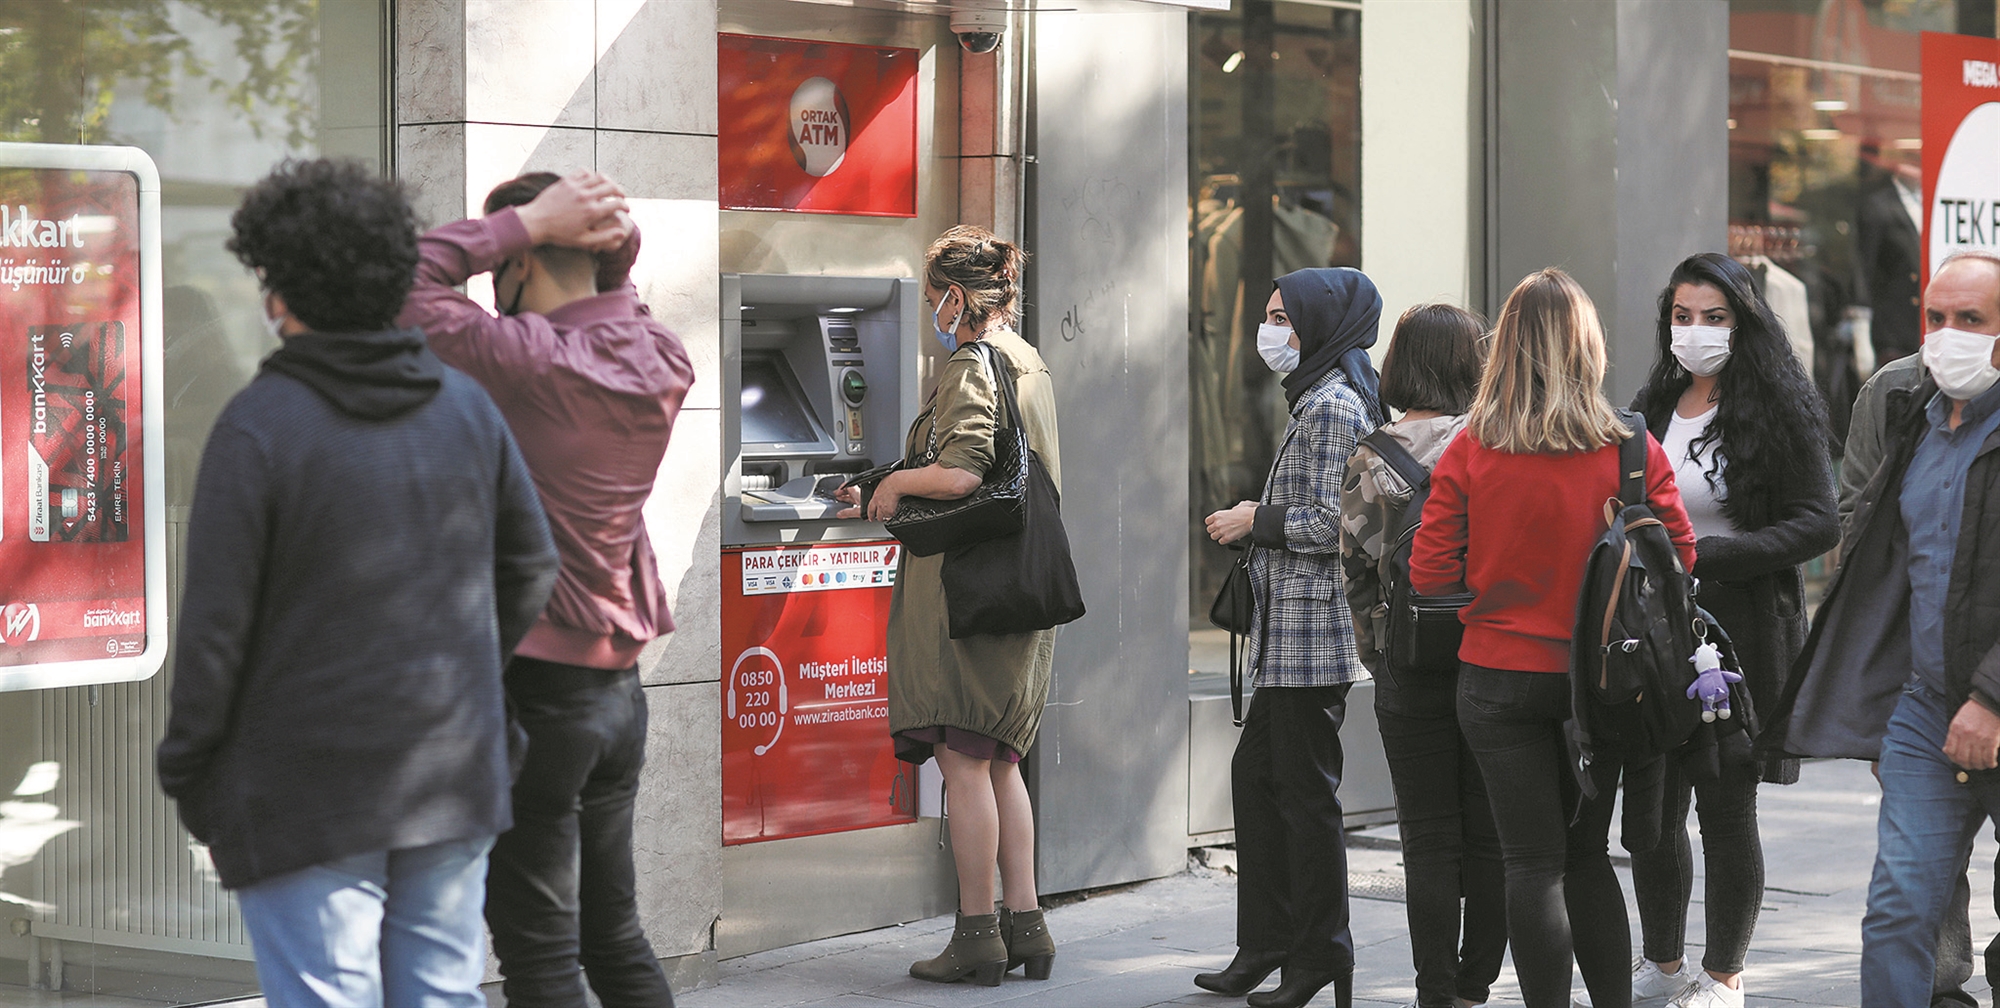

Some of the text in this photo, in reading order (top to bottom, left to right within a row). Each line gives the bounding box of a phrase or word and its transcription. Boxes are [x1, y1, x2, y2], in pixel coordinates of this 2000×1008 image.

[1962, 59, 1998, 88] MEGA
[800, 109, 838, 124] ORTAK
[799, 124, 839, 146] ATM
[0, 204, 84, 248] kkart
[1940, 199, 1985, 245] TEK
[0, 257, 85, 291] üşünür o
[85, 390, 96, 522] 5423 7400 0000 0000
[35, 498, 43, 524] Ziraat
[114, 493, 122, 522] EMRE
[745, 556, 774, 570] PARA
[777, 551, 819, 570] ÇEKİLİR
[829, 550, 880, 565] YATIRILIR
[740, 670, 774, 688] 0850
[799, 655, 887, 680] Müşteri İletişi
[745, 691, 770, 707] 220
[825, 679, 876, 699] Merkezi
[739, 711, 777, 729] 00 00
[793, 705, 888, 726] www.ziraatbank.co
